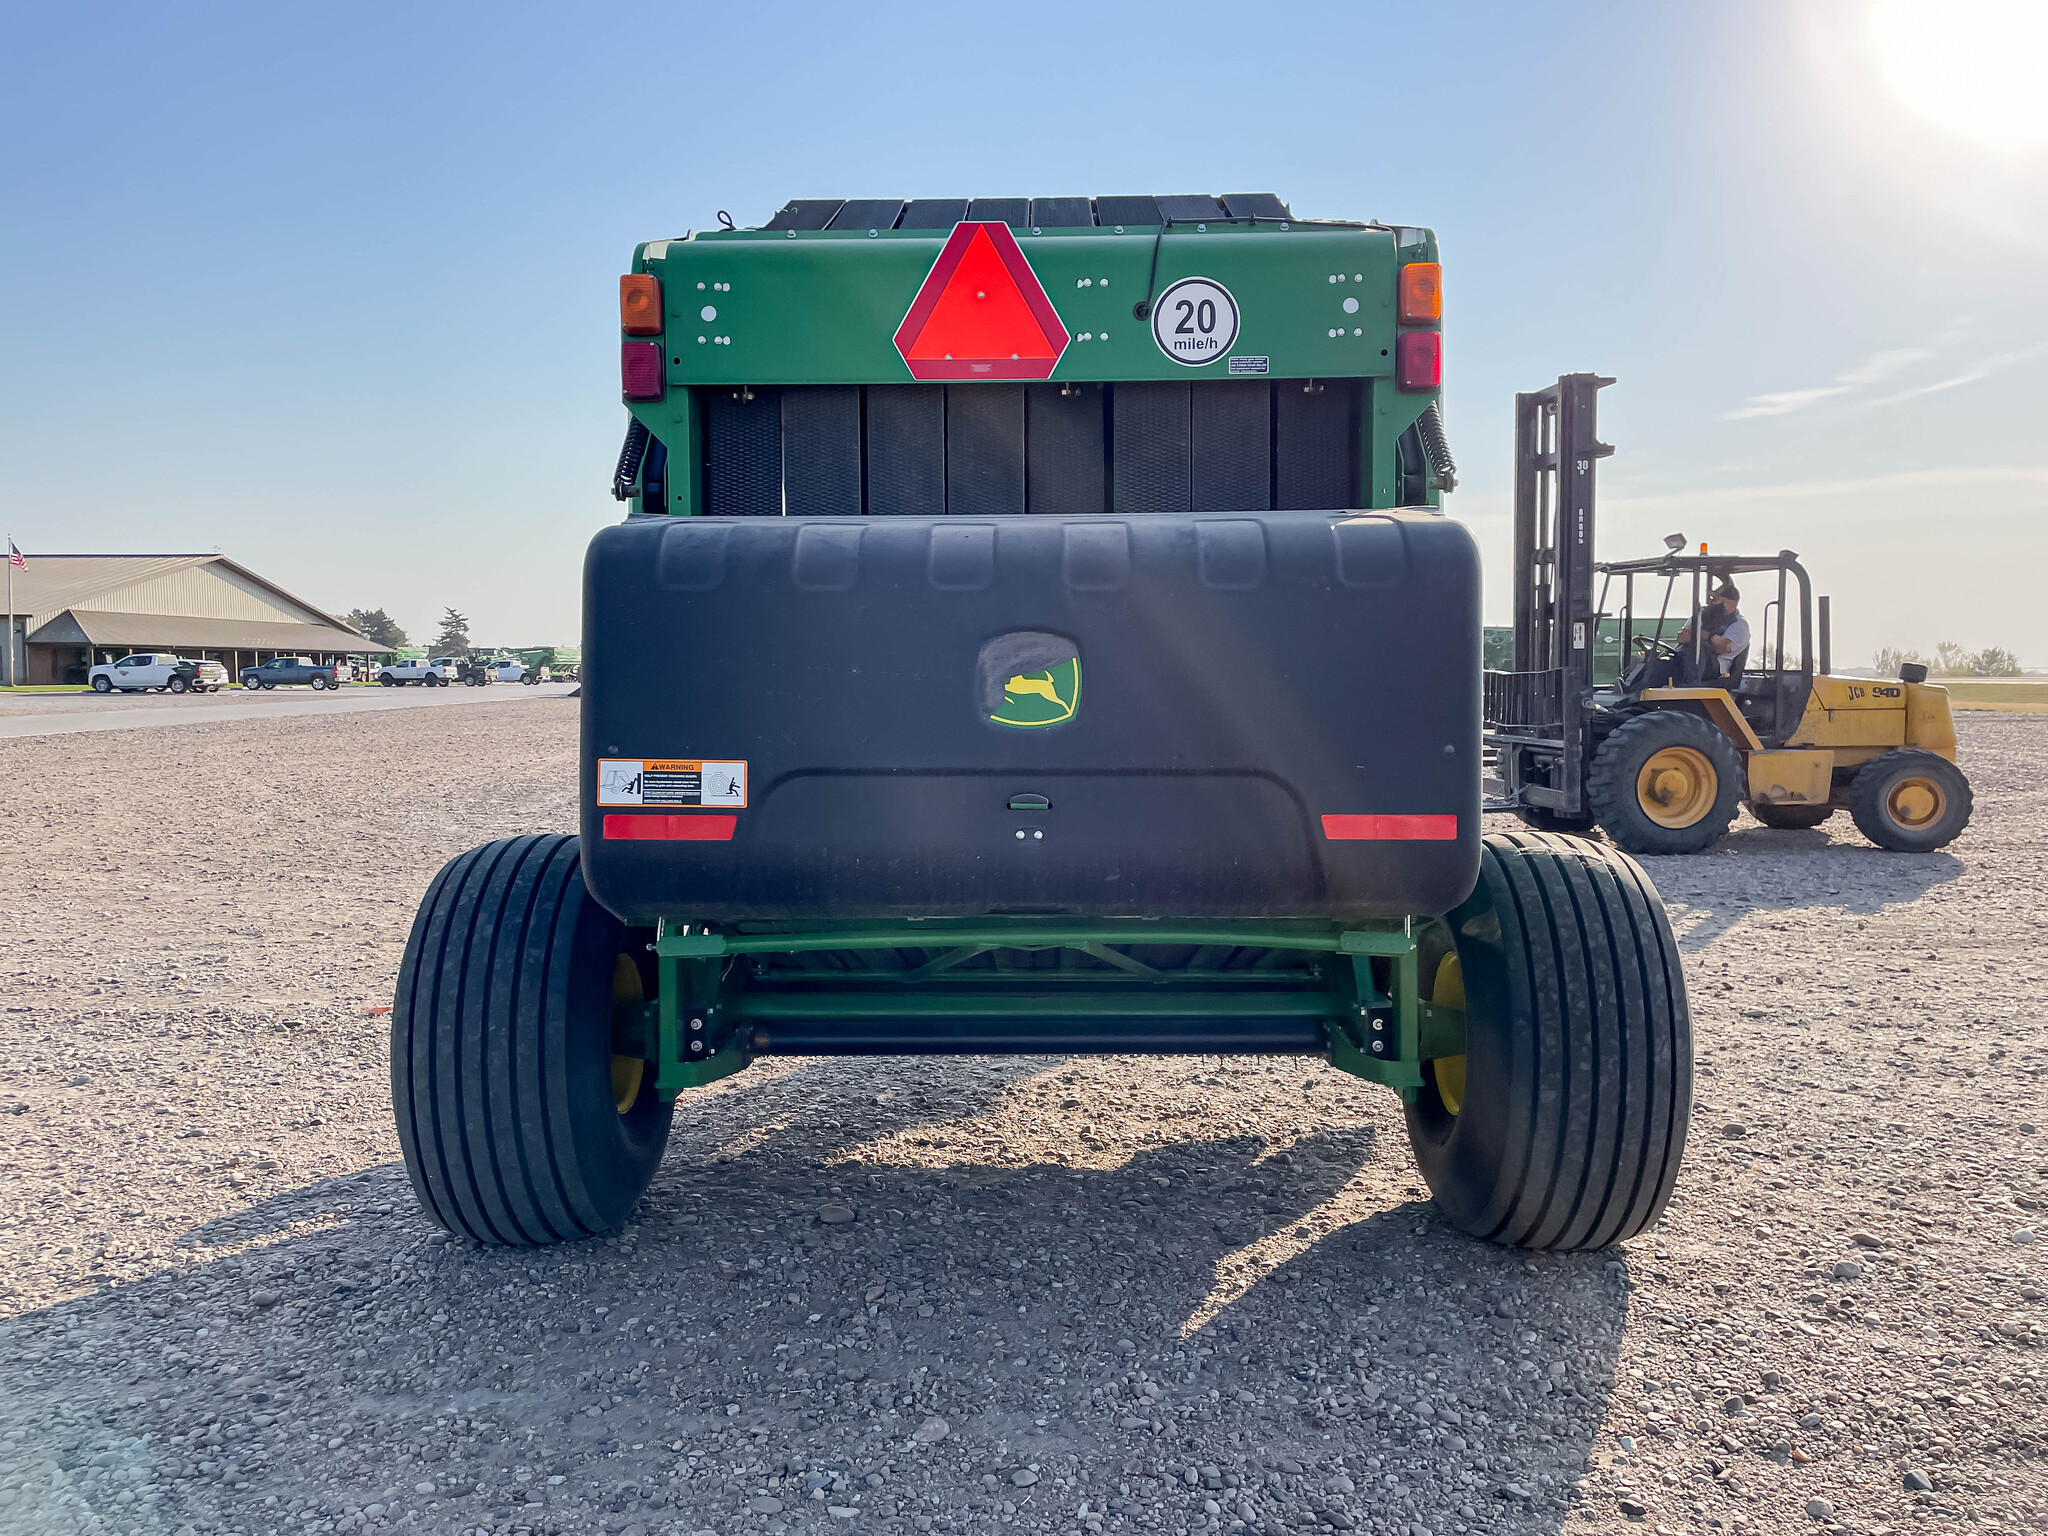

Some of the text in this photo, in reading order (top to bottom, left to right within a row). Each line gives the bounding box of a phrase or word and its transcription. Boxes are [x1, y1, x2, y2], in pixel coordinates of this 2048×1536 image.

[1175, 299, 1217, 334] 20
[1174, 337, 1218, 350] mile/h
[1577, 460, 1589, 470] 30
[1848, 686, 1901, 701] JCB 940
